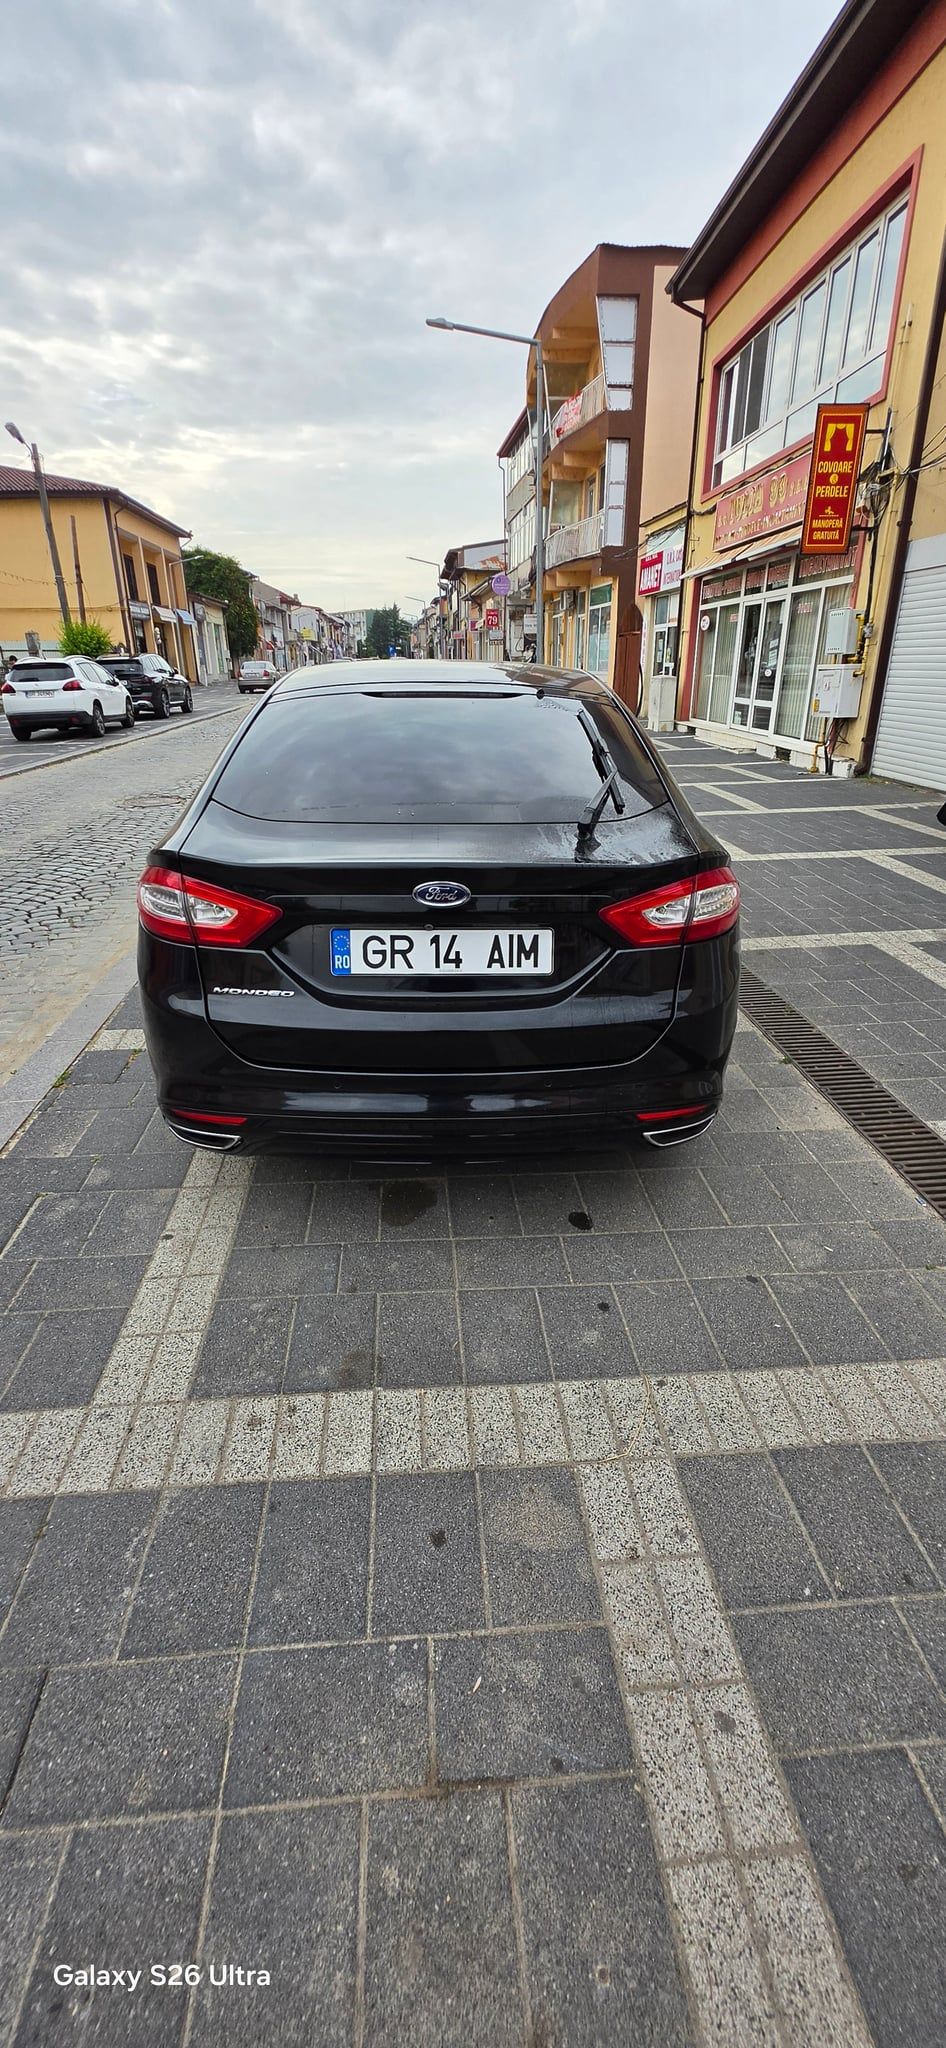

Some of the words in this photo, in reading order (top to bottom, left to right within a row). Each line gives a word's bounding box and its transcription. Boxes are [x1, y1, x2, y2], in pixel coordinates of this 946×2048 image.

[818, 461, 853, 473] COVOARE
[815, 485, 849, 497] PERDELE
[487, 615, 498, 625] 79
[425, 886, 457, 901] Ford
[362, 935, 415, 969] GR
[430, 934, 463, 969] 14
[486, 934, 540, 969] AIM
[334, 954, 350, 969] RO
[213, 986, 295, 997] MONDEO
